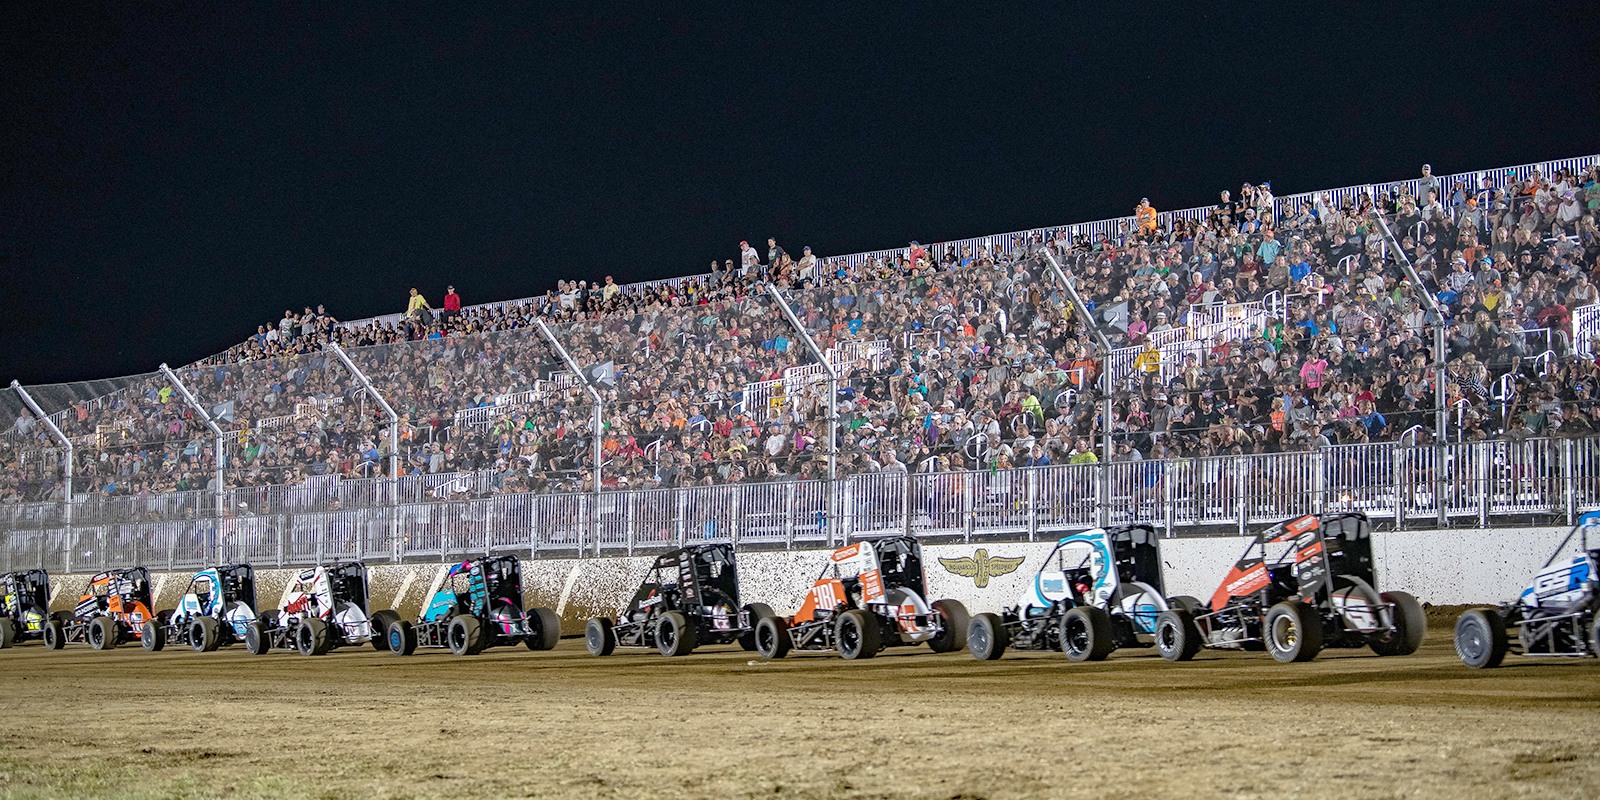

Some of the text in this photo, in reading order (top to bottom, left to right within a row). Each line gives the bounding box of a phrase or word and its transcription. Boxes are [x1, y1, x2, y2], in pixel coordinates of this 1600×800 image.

[1393, 185, 1399, 196] 9
[948, 563, 977, 571] INDIANAPOLIS
[991, 563, 1014, 571] SPEEDWAY
